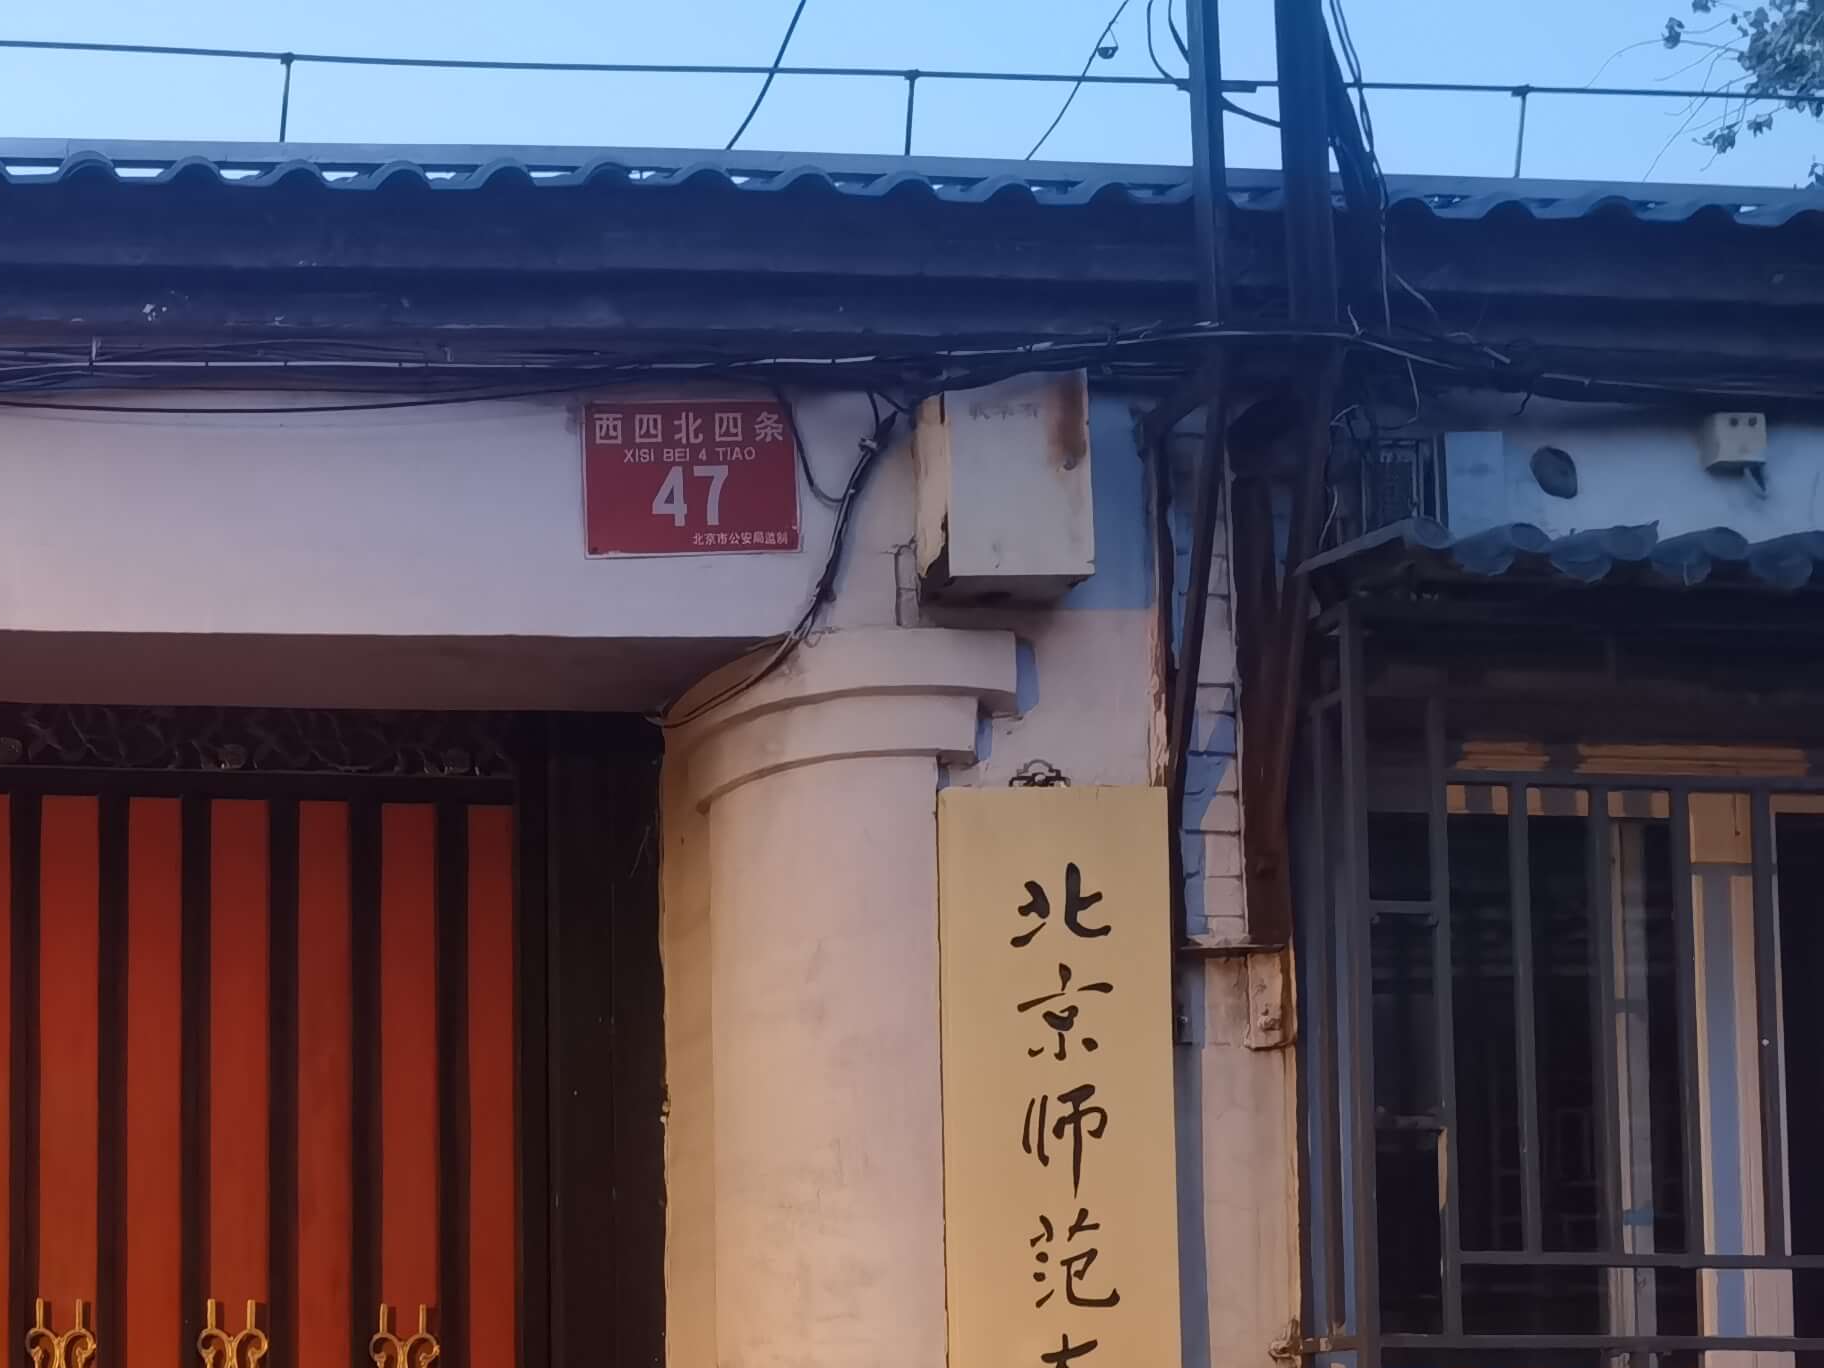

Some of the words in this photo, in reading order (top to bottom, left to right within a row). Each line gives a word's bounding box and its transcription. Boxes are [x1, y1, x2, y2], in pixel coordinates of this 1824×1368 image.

[593, 411, 784, 444] 西四北四条
[623, 448, 654, 464] XISI
[663, 448, 690, 462] BEI
[698, 448, 707, 461] 4
[715, 446, 756, 461] TIAO
[651, 465, 729, 527] 47
[692, 531, 788, 546] 北京市公安局监制
